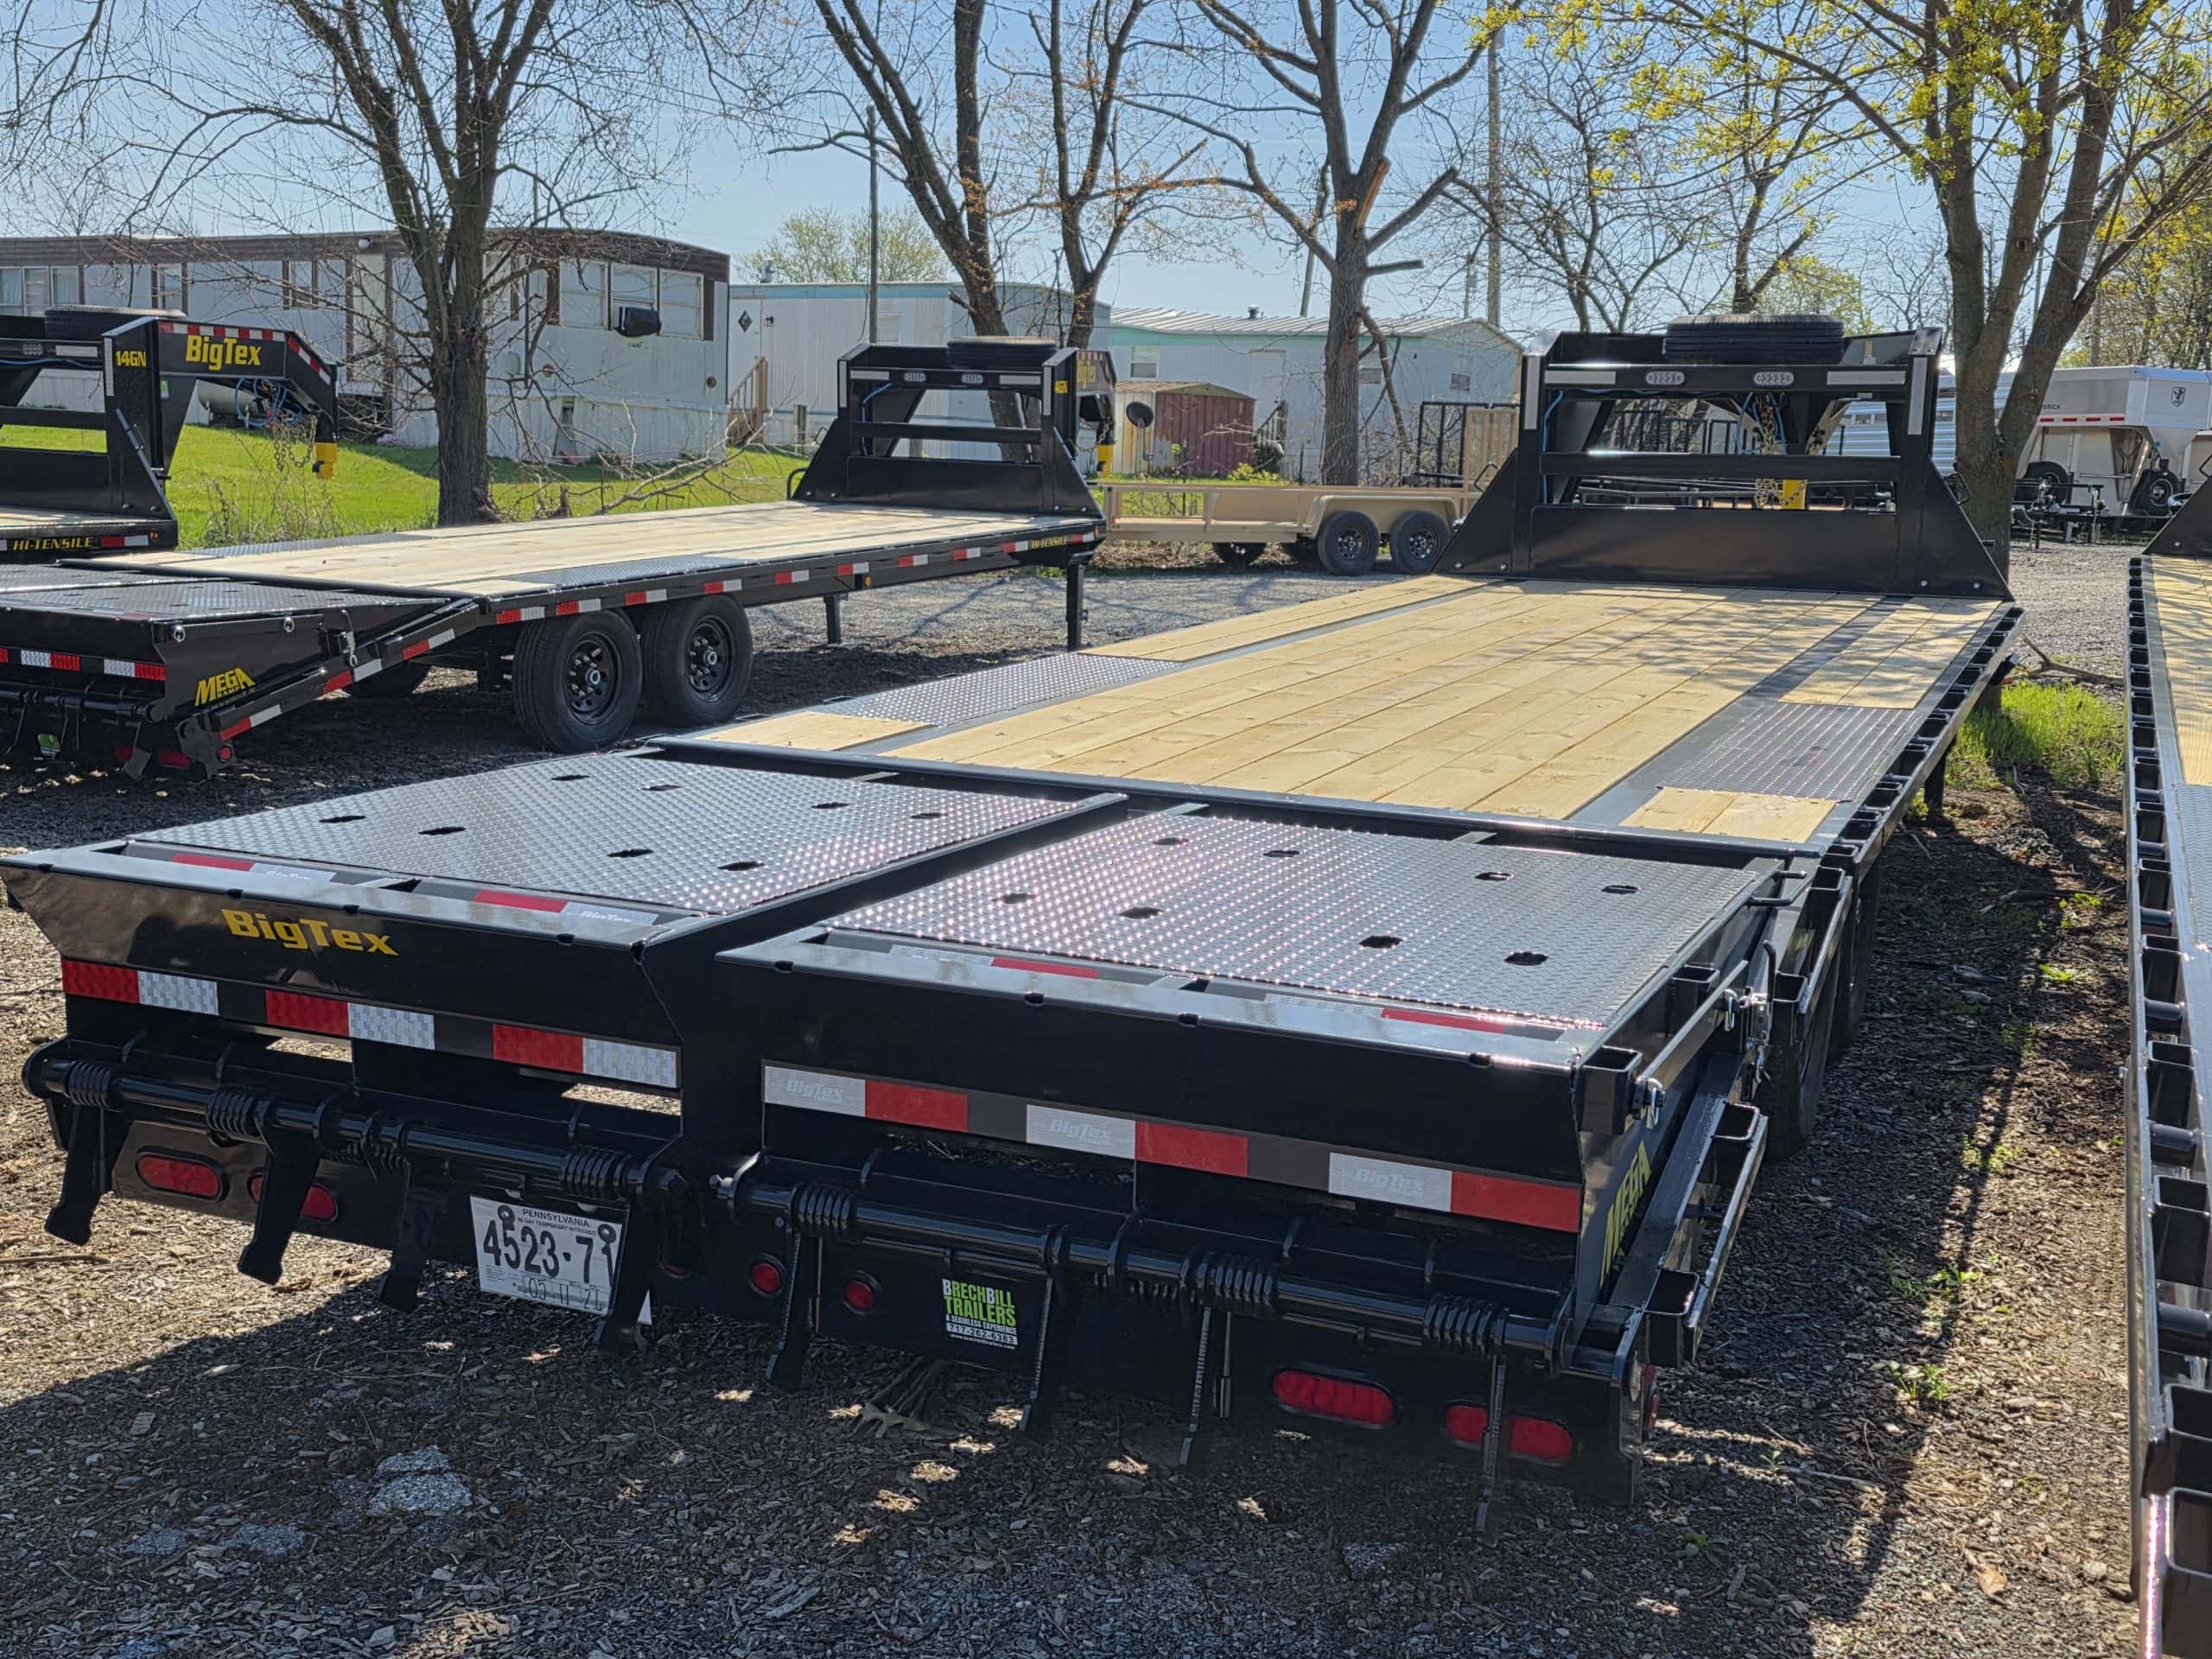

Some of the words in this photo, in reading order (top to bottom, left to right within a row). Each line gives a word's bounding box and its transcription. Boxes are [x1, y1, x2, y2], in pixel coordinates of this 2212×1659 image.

[116, 350, 147, 367] 14GN
[186, 334, 261, 371] BigTex
[13, 537, 94, 550] HI-TENSILE
[194, 667, 257, 707] MEGA
[221, 909, 399, 956] BigTex
[522, 1210, 589, 1228] PENNSYLVANIA
[1599, 1140, 1651, 1287] MEGA
[942, 1279, 1015, 1308] BRECHBILL
[944, 1295, 1016, 1327] TRAILERS
